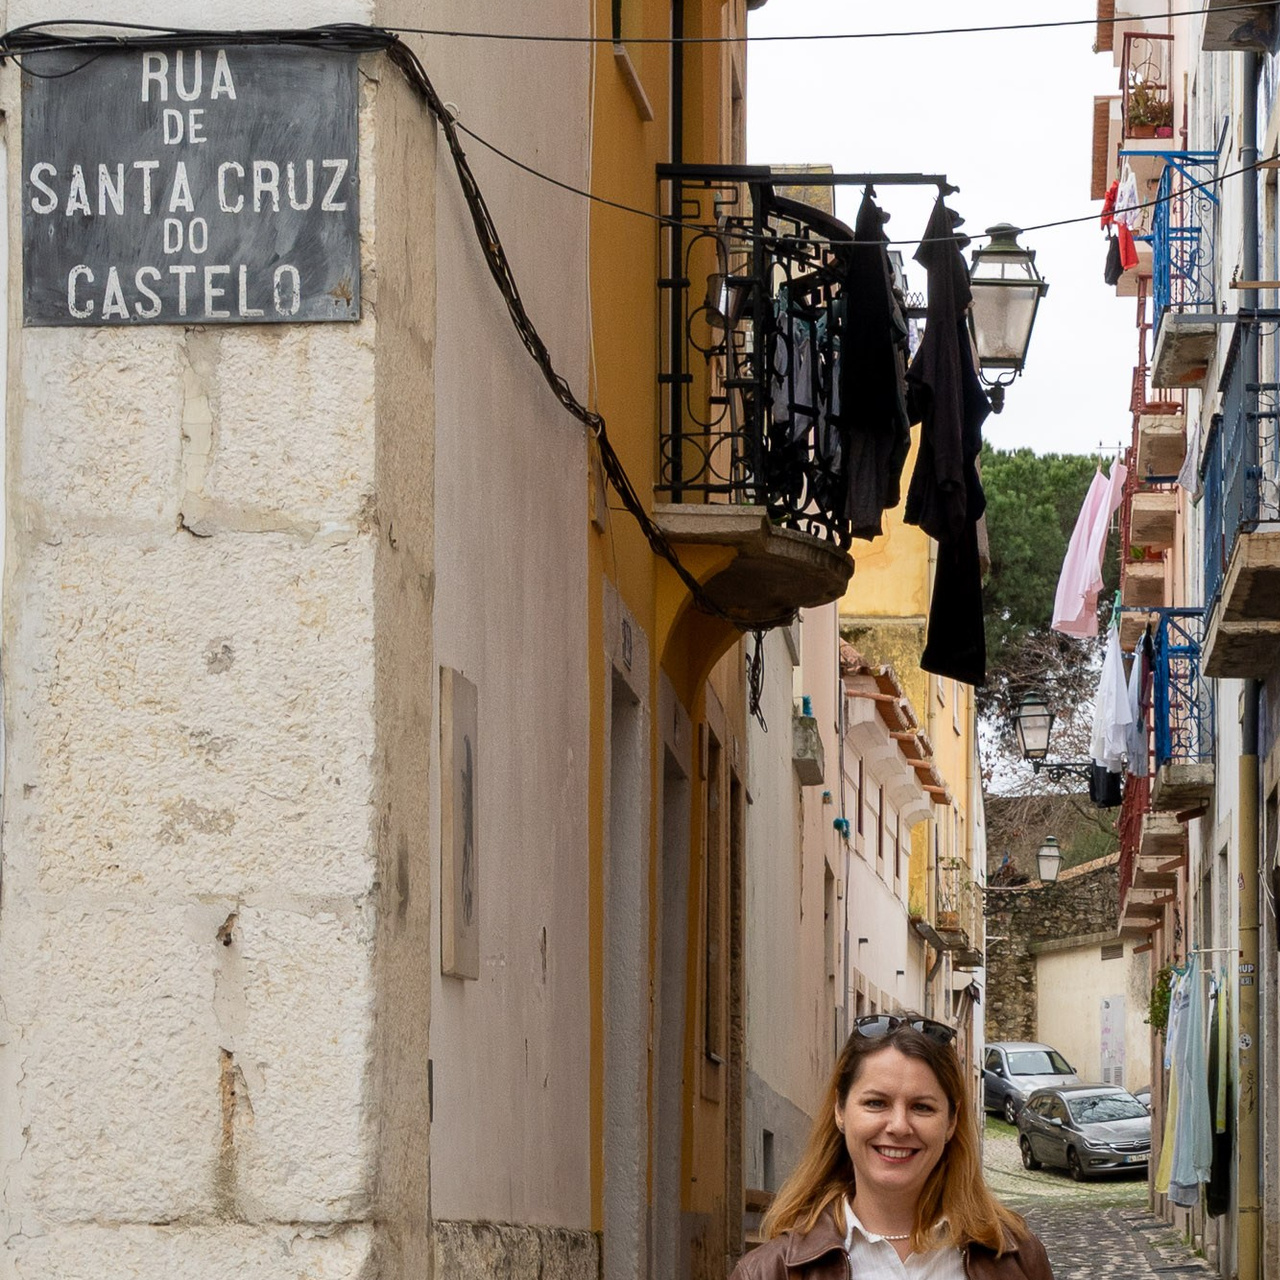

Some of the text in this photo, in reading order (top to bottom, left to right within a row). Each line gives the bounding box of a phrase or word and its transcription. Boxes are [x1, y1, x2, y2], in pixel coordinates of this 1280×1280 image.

[141, 49, 237, 103] RUA
[162, 108, 208, 145] DE
[29, 158, 349, 217] SANTA CRUZ
[162, 216, 209, 255] DO
[67, 264, 301, 320] CASTELO
